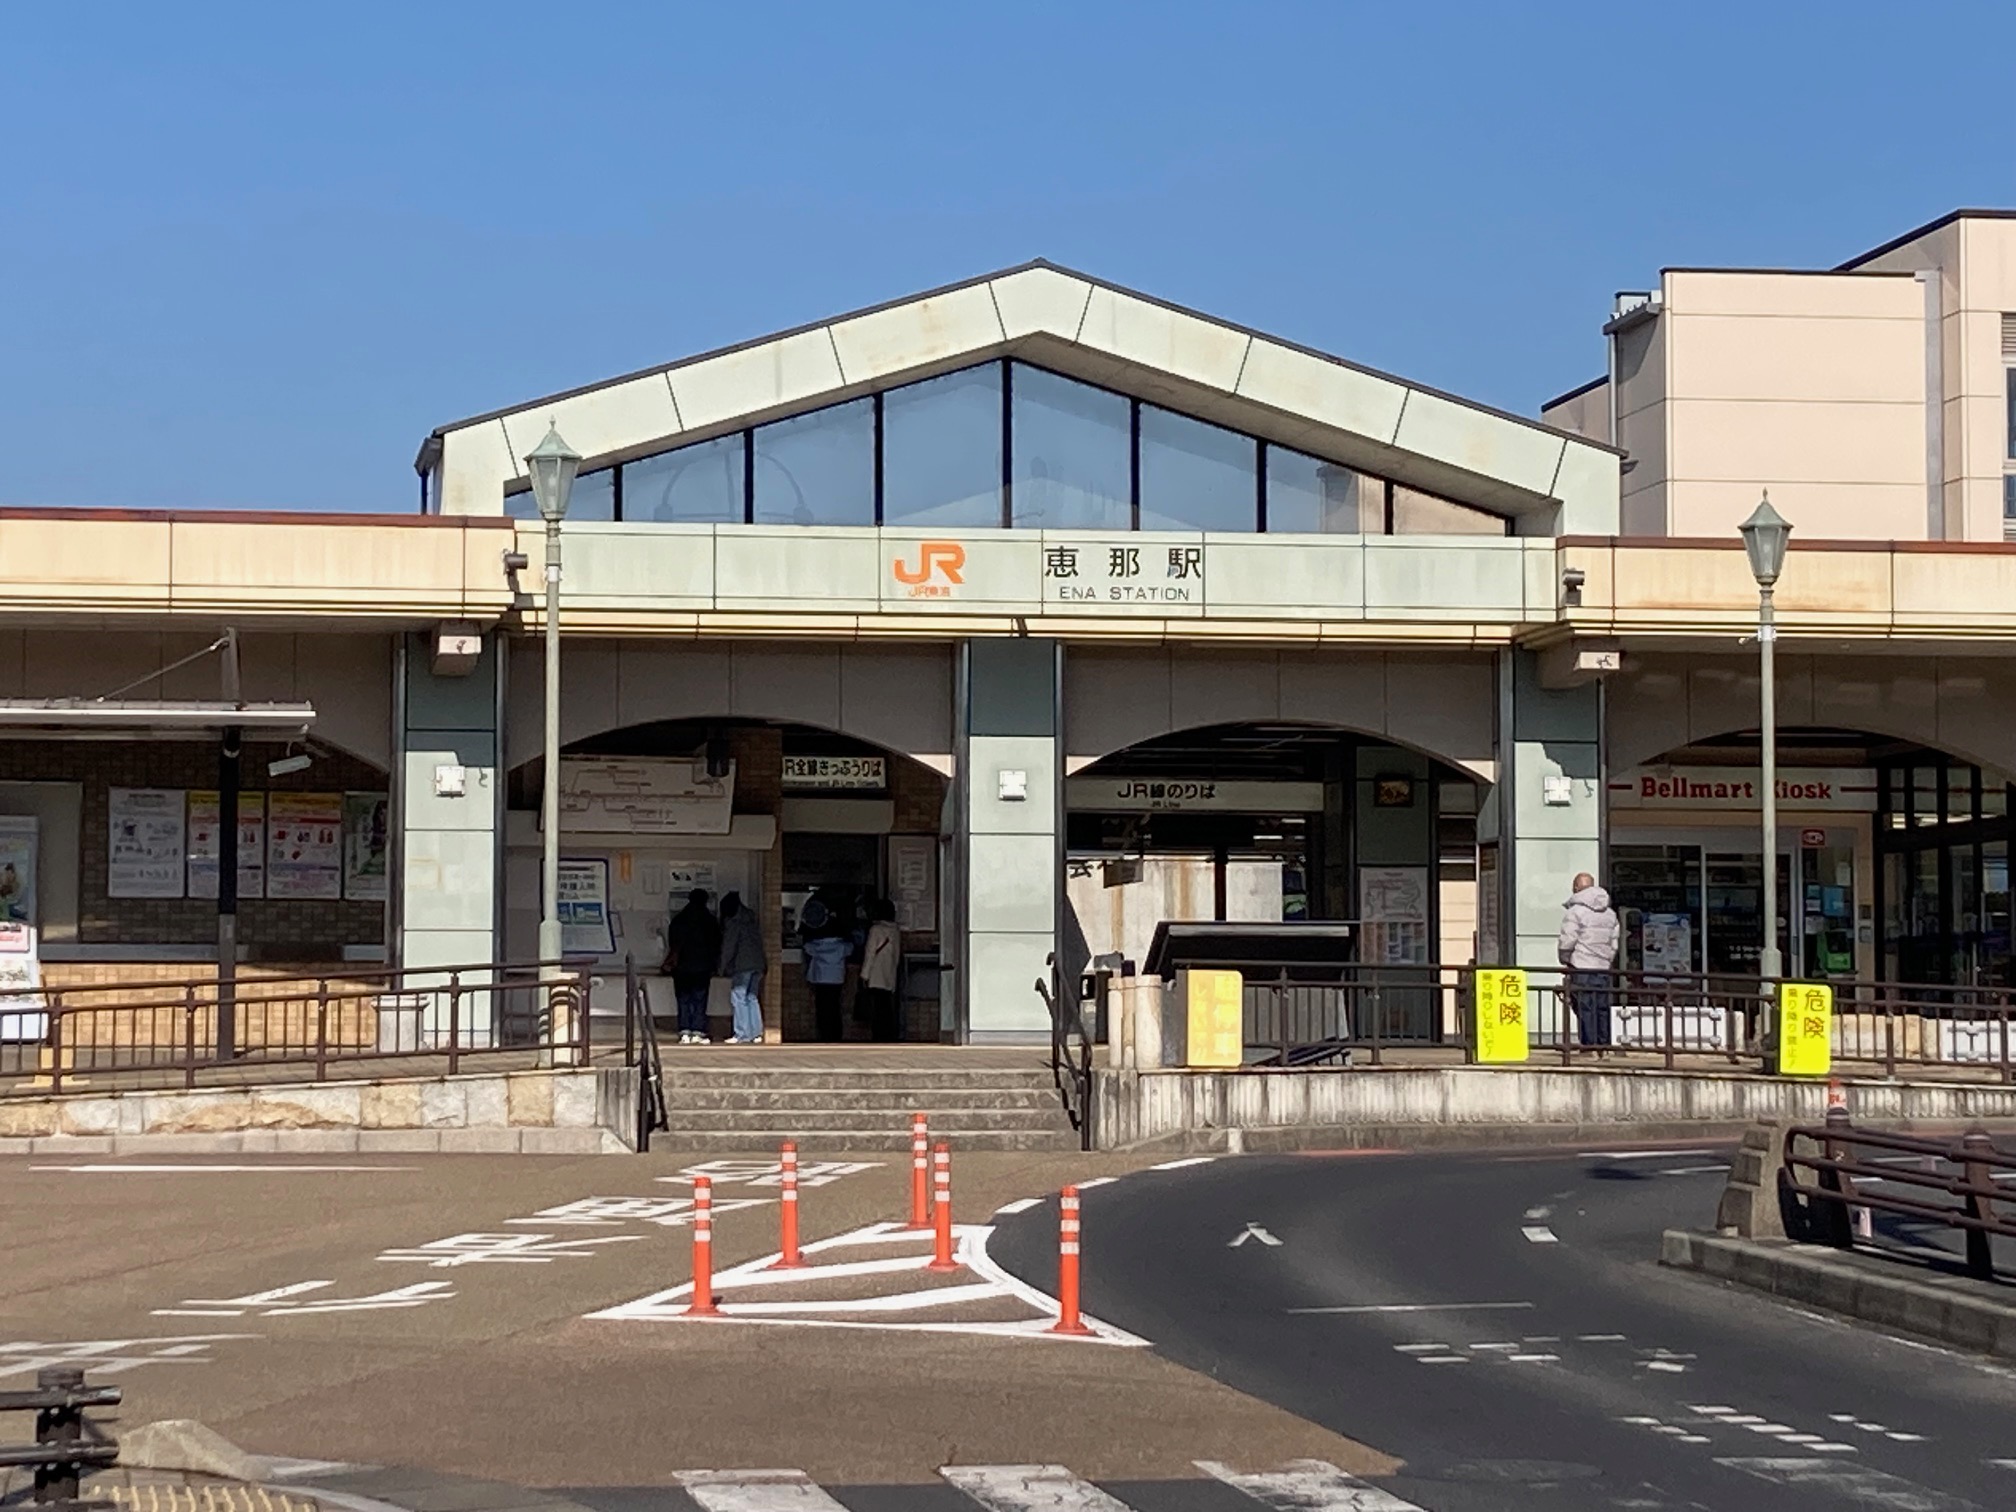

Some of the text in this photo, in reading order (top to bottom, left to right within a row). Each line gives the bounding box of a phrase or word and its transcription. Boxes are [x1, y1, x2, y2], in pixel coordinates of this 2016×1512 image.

[895, 538, 966, 585] JR
[1044, 545, 1202, 579] 恵那駅
[1059, 586, 1191, 602] ENA STATION
[784, 758, 881, 777] R全線きっぷうりば
[1117, 782, 1216, 800] JR線のりば
[1641, 776, 1753, 799] Bellmart
[1499, 973, 1522, 1026] 危険
[1803, 987, 1826, 1040] 危険
